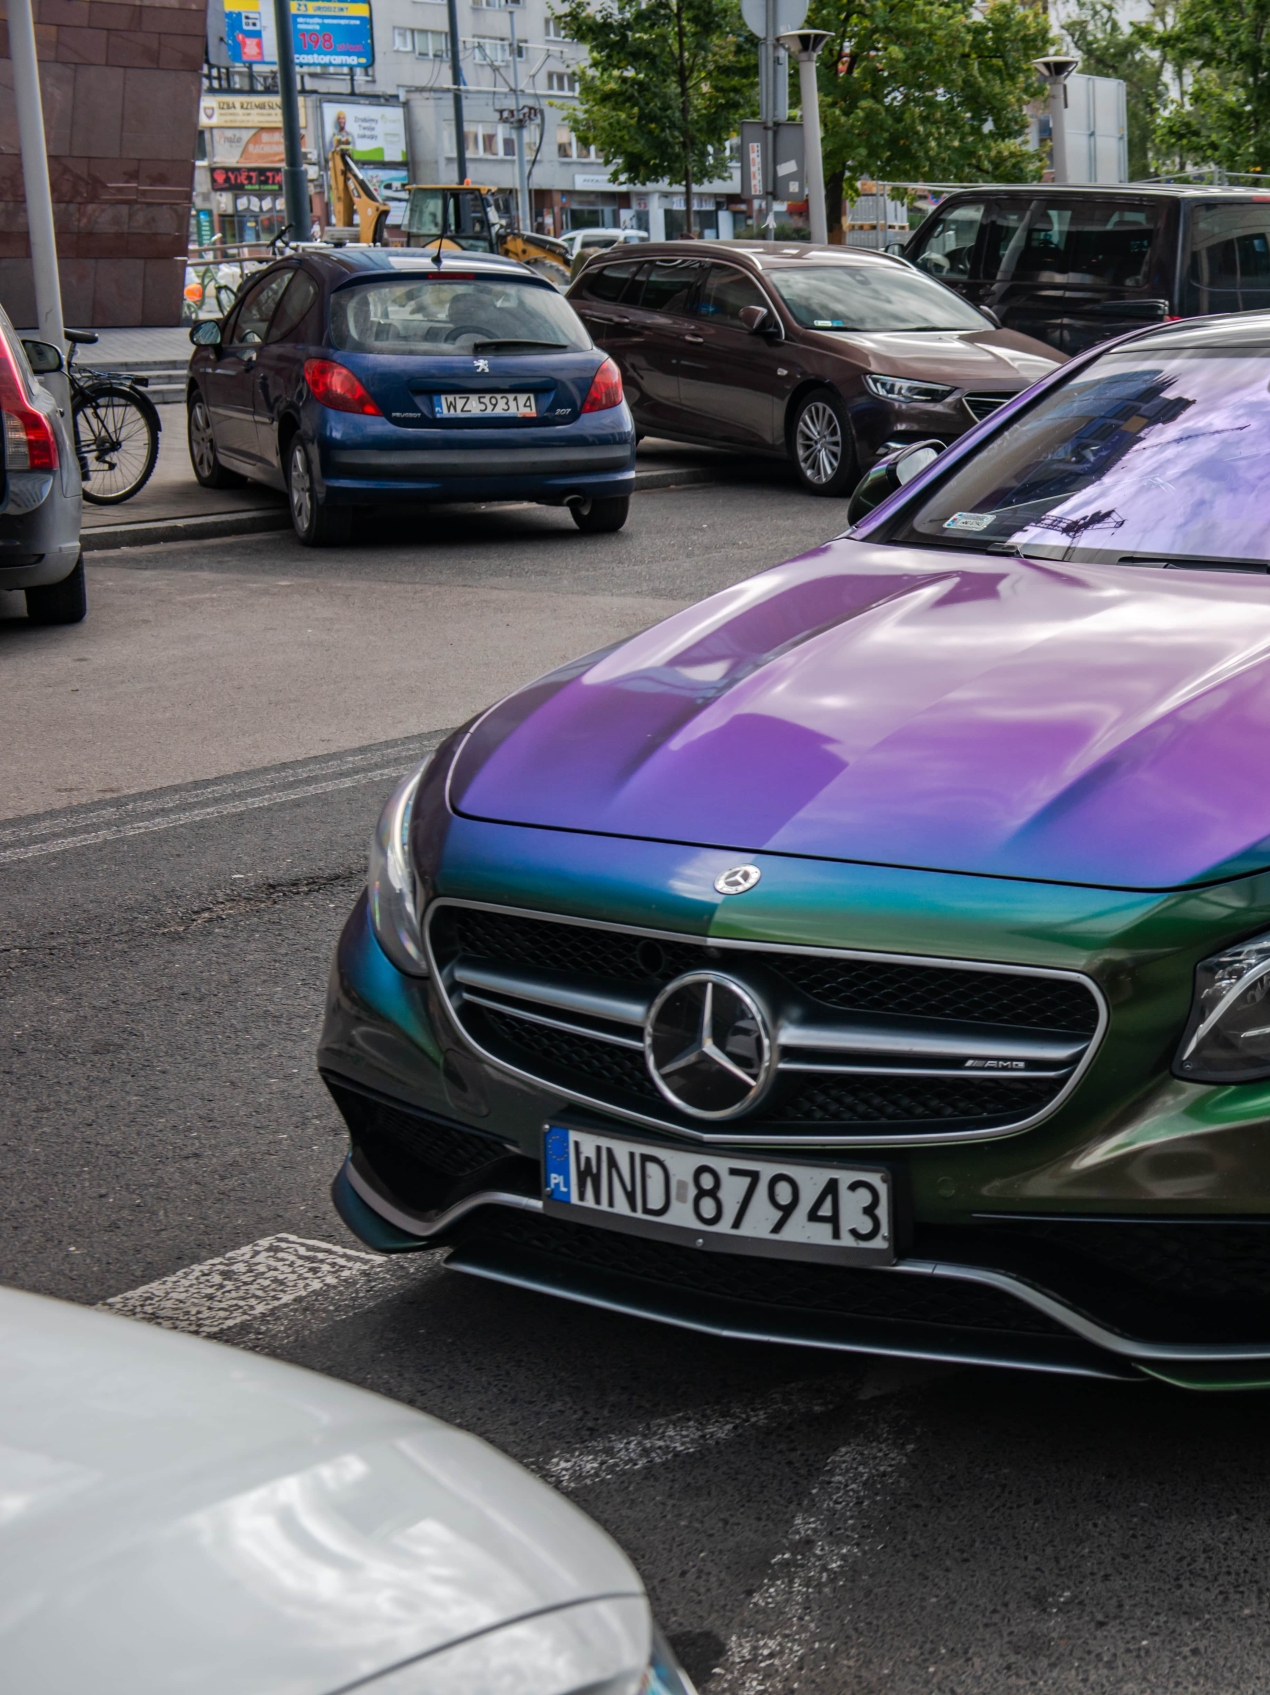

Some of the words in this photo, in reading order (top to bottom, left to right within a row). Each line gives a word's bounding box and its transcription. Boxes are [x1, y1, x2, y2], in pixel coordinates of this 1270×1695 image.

[312, 5, 350, 13] URODZINY
[299, 32, 334, 51] 198
[295, 53, 358, 65] castorama
[218, 100, 236, 110] IZBA
[358, 124, 376, 132] Twoje
[445, 396, 472, 413] WZ
[478, 395, 533, 412] 59314
[983, 1060, 1026, 1069] AMG
[550, 1173, 568, 1193] PL
[573, 1140, 672, 1218] WND
[692, 1164, 881, 1241] 87943
